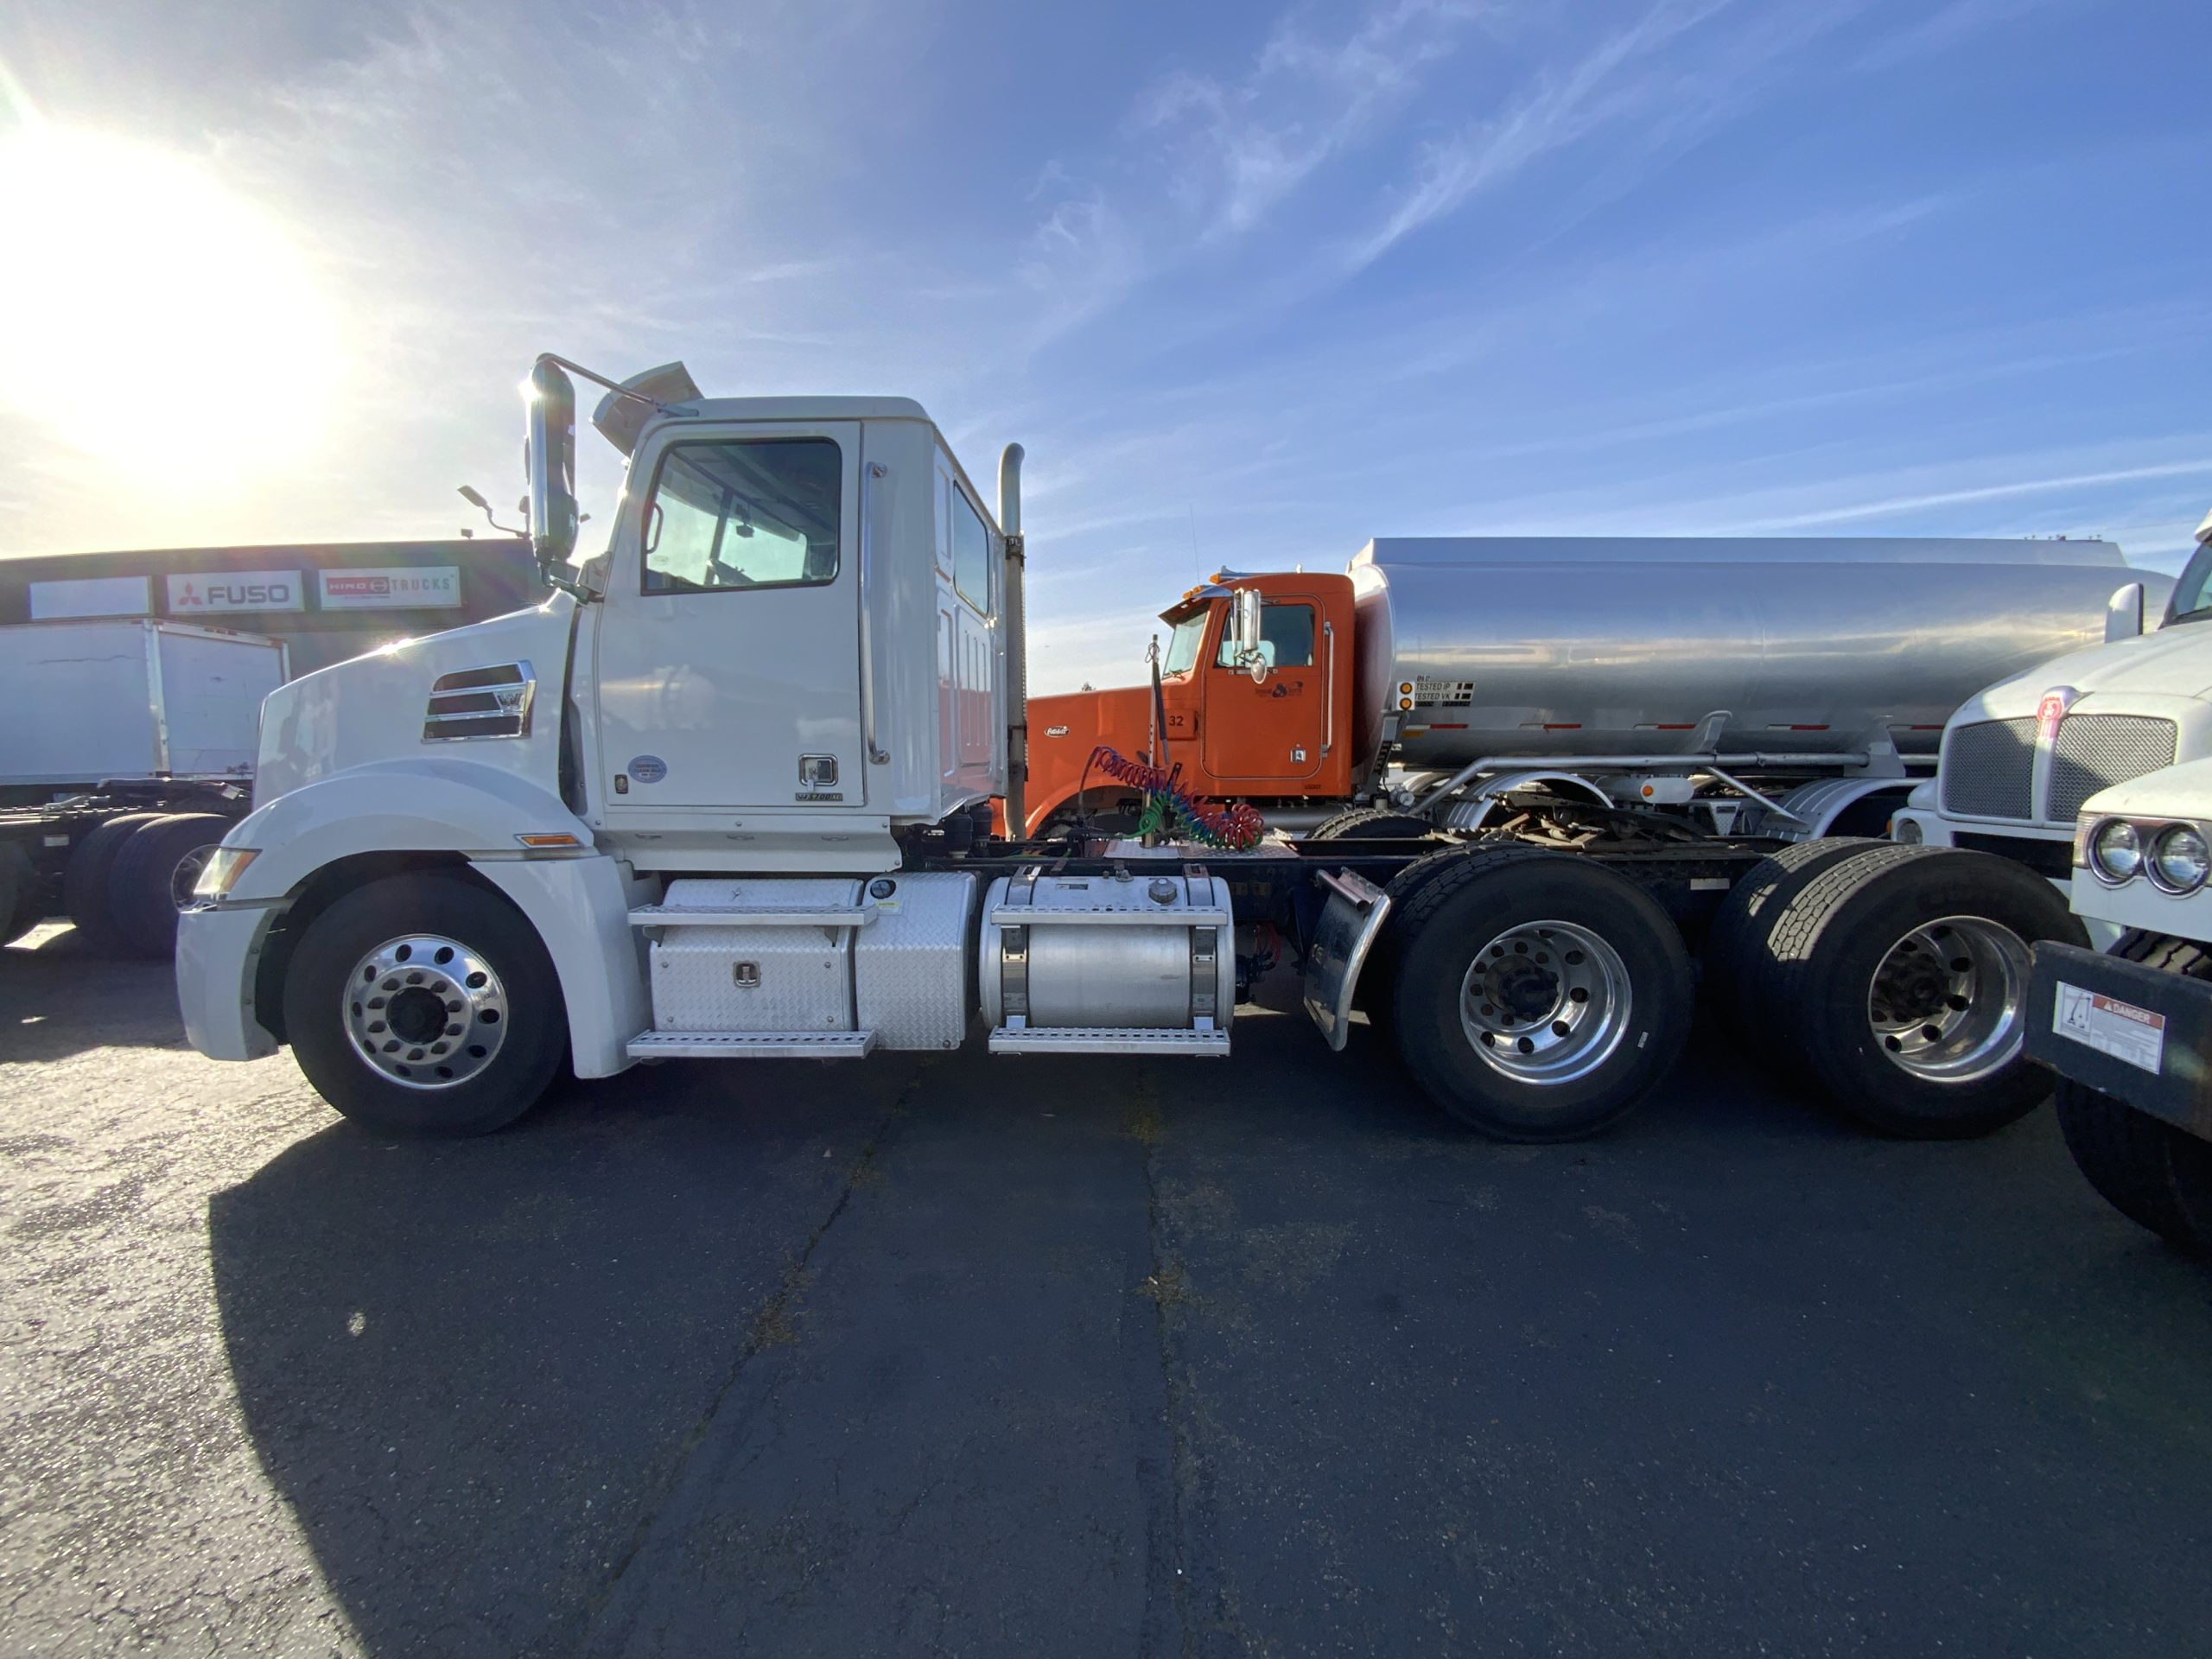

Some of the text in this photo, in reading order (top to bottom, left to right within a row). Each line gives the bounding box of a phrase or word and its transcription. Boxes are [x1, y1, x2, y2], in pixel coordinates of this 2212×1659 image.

[391, 577, 450, 590] TRUCKS
[207, 584, 289, 604] FUSO
[1168, 715, 1184, 727] 32
[2113, 1003, 2151, 1025] DANGER
